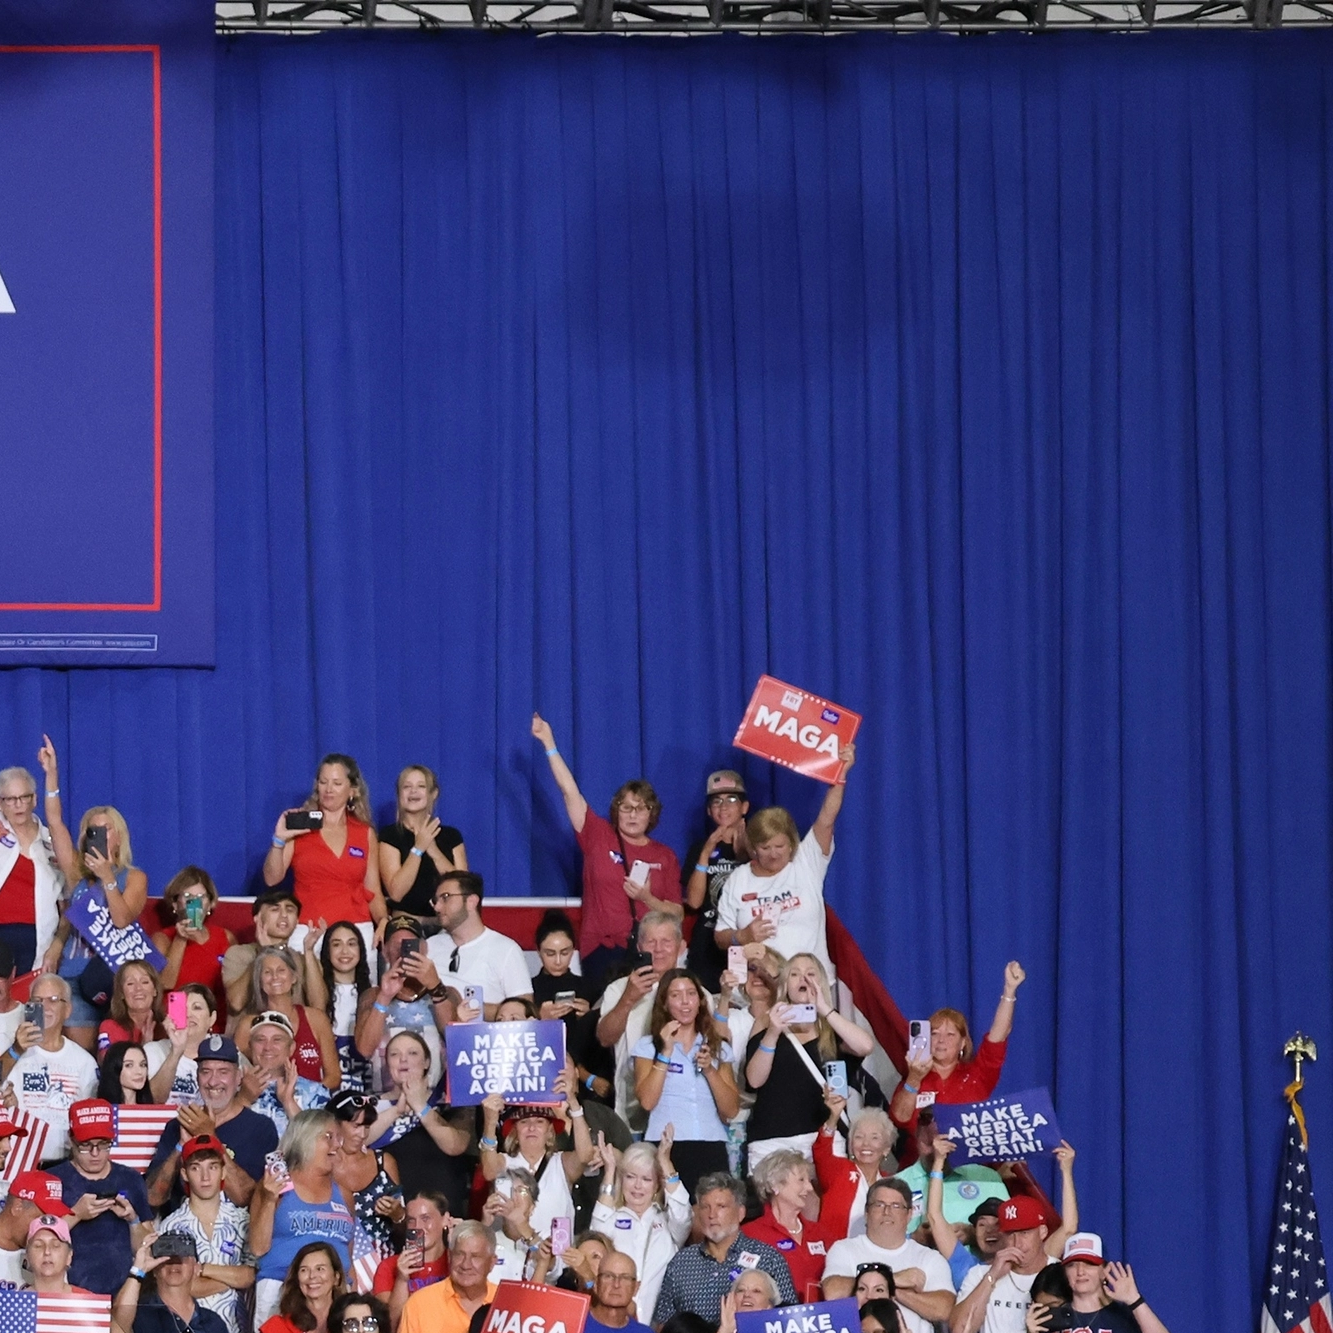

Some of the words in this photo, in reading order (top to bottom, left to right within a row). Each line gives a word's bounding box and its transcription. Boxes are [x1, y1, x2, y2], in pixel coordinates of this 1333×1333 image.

[753, 704, 840, 760] MAGA
[757, 890, 793, 905] TEAM
[474, 1032, 536, 1050] MAKE
[302, 1048, 319, 1059] USA
[456, 1046, 557, 1066] AMERICA
[470, 1063, 543, 1080] GREAT
[469, 1076, 547, 1096] AGAIN!
[961, 1103, 1024, 1127] MAKE
[947, 1112, 1048, 1140] AMERICA
[966, 1128, 1037, 1150] GREAT
[967, 1140, 1045, 1158] AGAIN!
